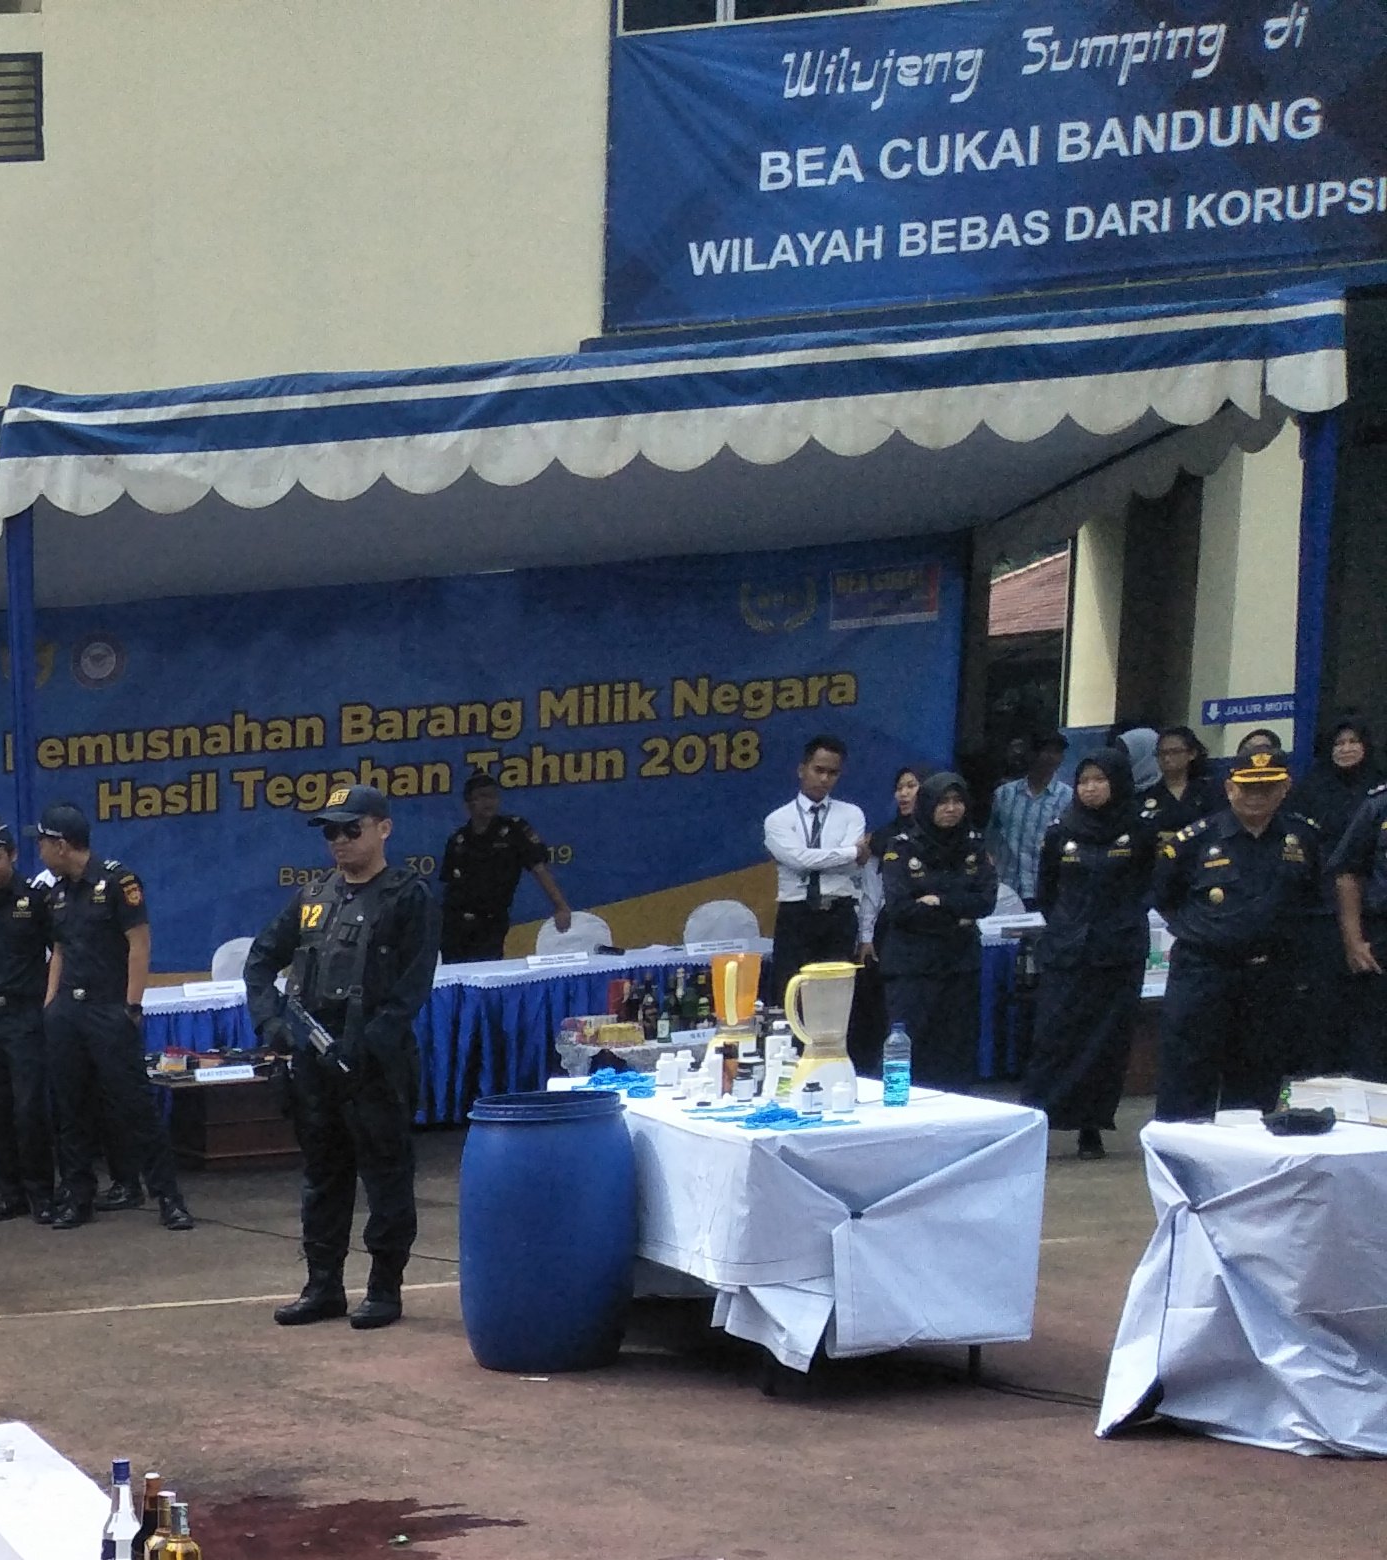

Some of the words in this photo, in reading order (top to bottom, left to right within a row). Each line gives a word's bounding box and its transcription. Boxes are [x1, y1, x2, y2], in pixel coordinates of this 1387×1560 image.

[782, 45, 985, 110] Wilujeng
[1021, 24, 1227, 87] Sumping
[1264, 2, 1310, 51] di
[758, 147, 864, 192] BEA
[878, 125, 1039, 182] CUKAI
[1056, 97, 1322, 162] BANDUNG
[688, 226, 884, 277] WILAYAH
[898, 209, 1050, 259] BEBAS
[1065, 198, 1171, 244] DARI
[1185, 176, 1387, 230] KORUPSI
[339, 699, 524, 750] Barang
[538, 680, 657, 728] Milik
[672, 668, 858, 720] Negara
[97, 776, 218, 822] Hasil
[232, 758, 452, 812] Tegahan
[639, 733, 763, 779] 2018
[405, 855, 436, 876] 30
[301, 903, 324, 930] P2
